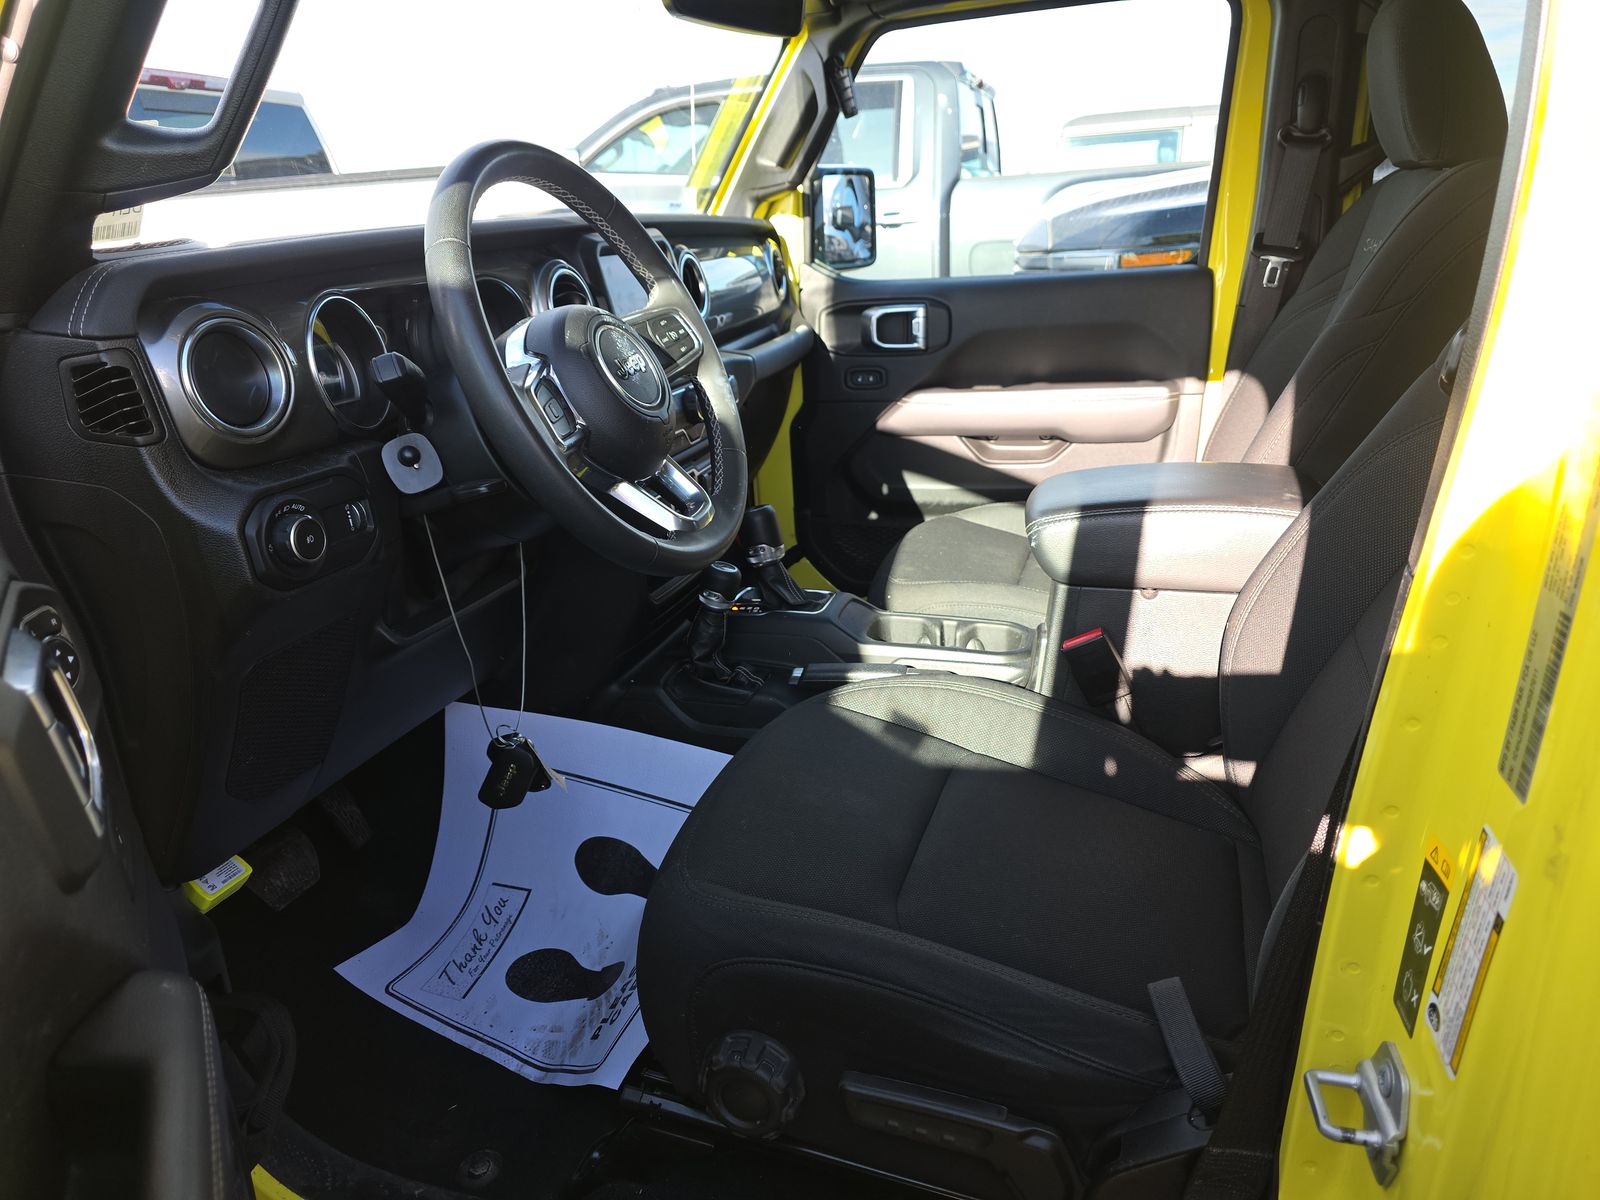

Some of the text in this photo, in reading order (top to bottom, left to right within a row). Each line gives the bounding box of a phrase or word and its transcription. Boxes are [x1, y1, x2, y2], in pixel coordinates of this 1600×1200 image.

[614, 353, 646, 380] Jeep
[291, 503, 306, 512] AUTO
[438, 896, 510, 986] Thank You
[468, 964, 480, 978] For
[488, 913, 513, 948] Patronage
[590, 965, 637, 1040] PLEAS
